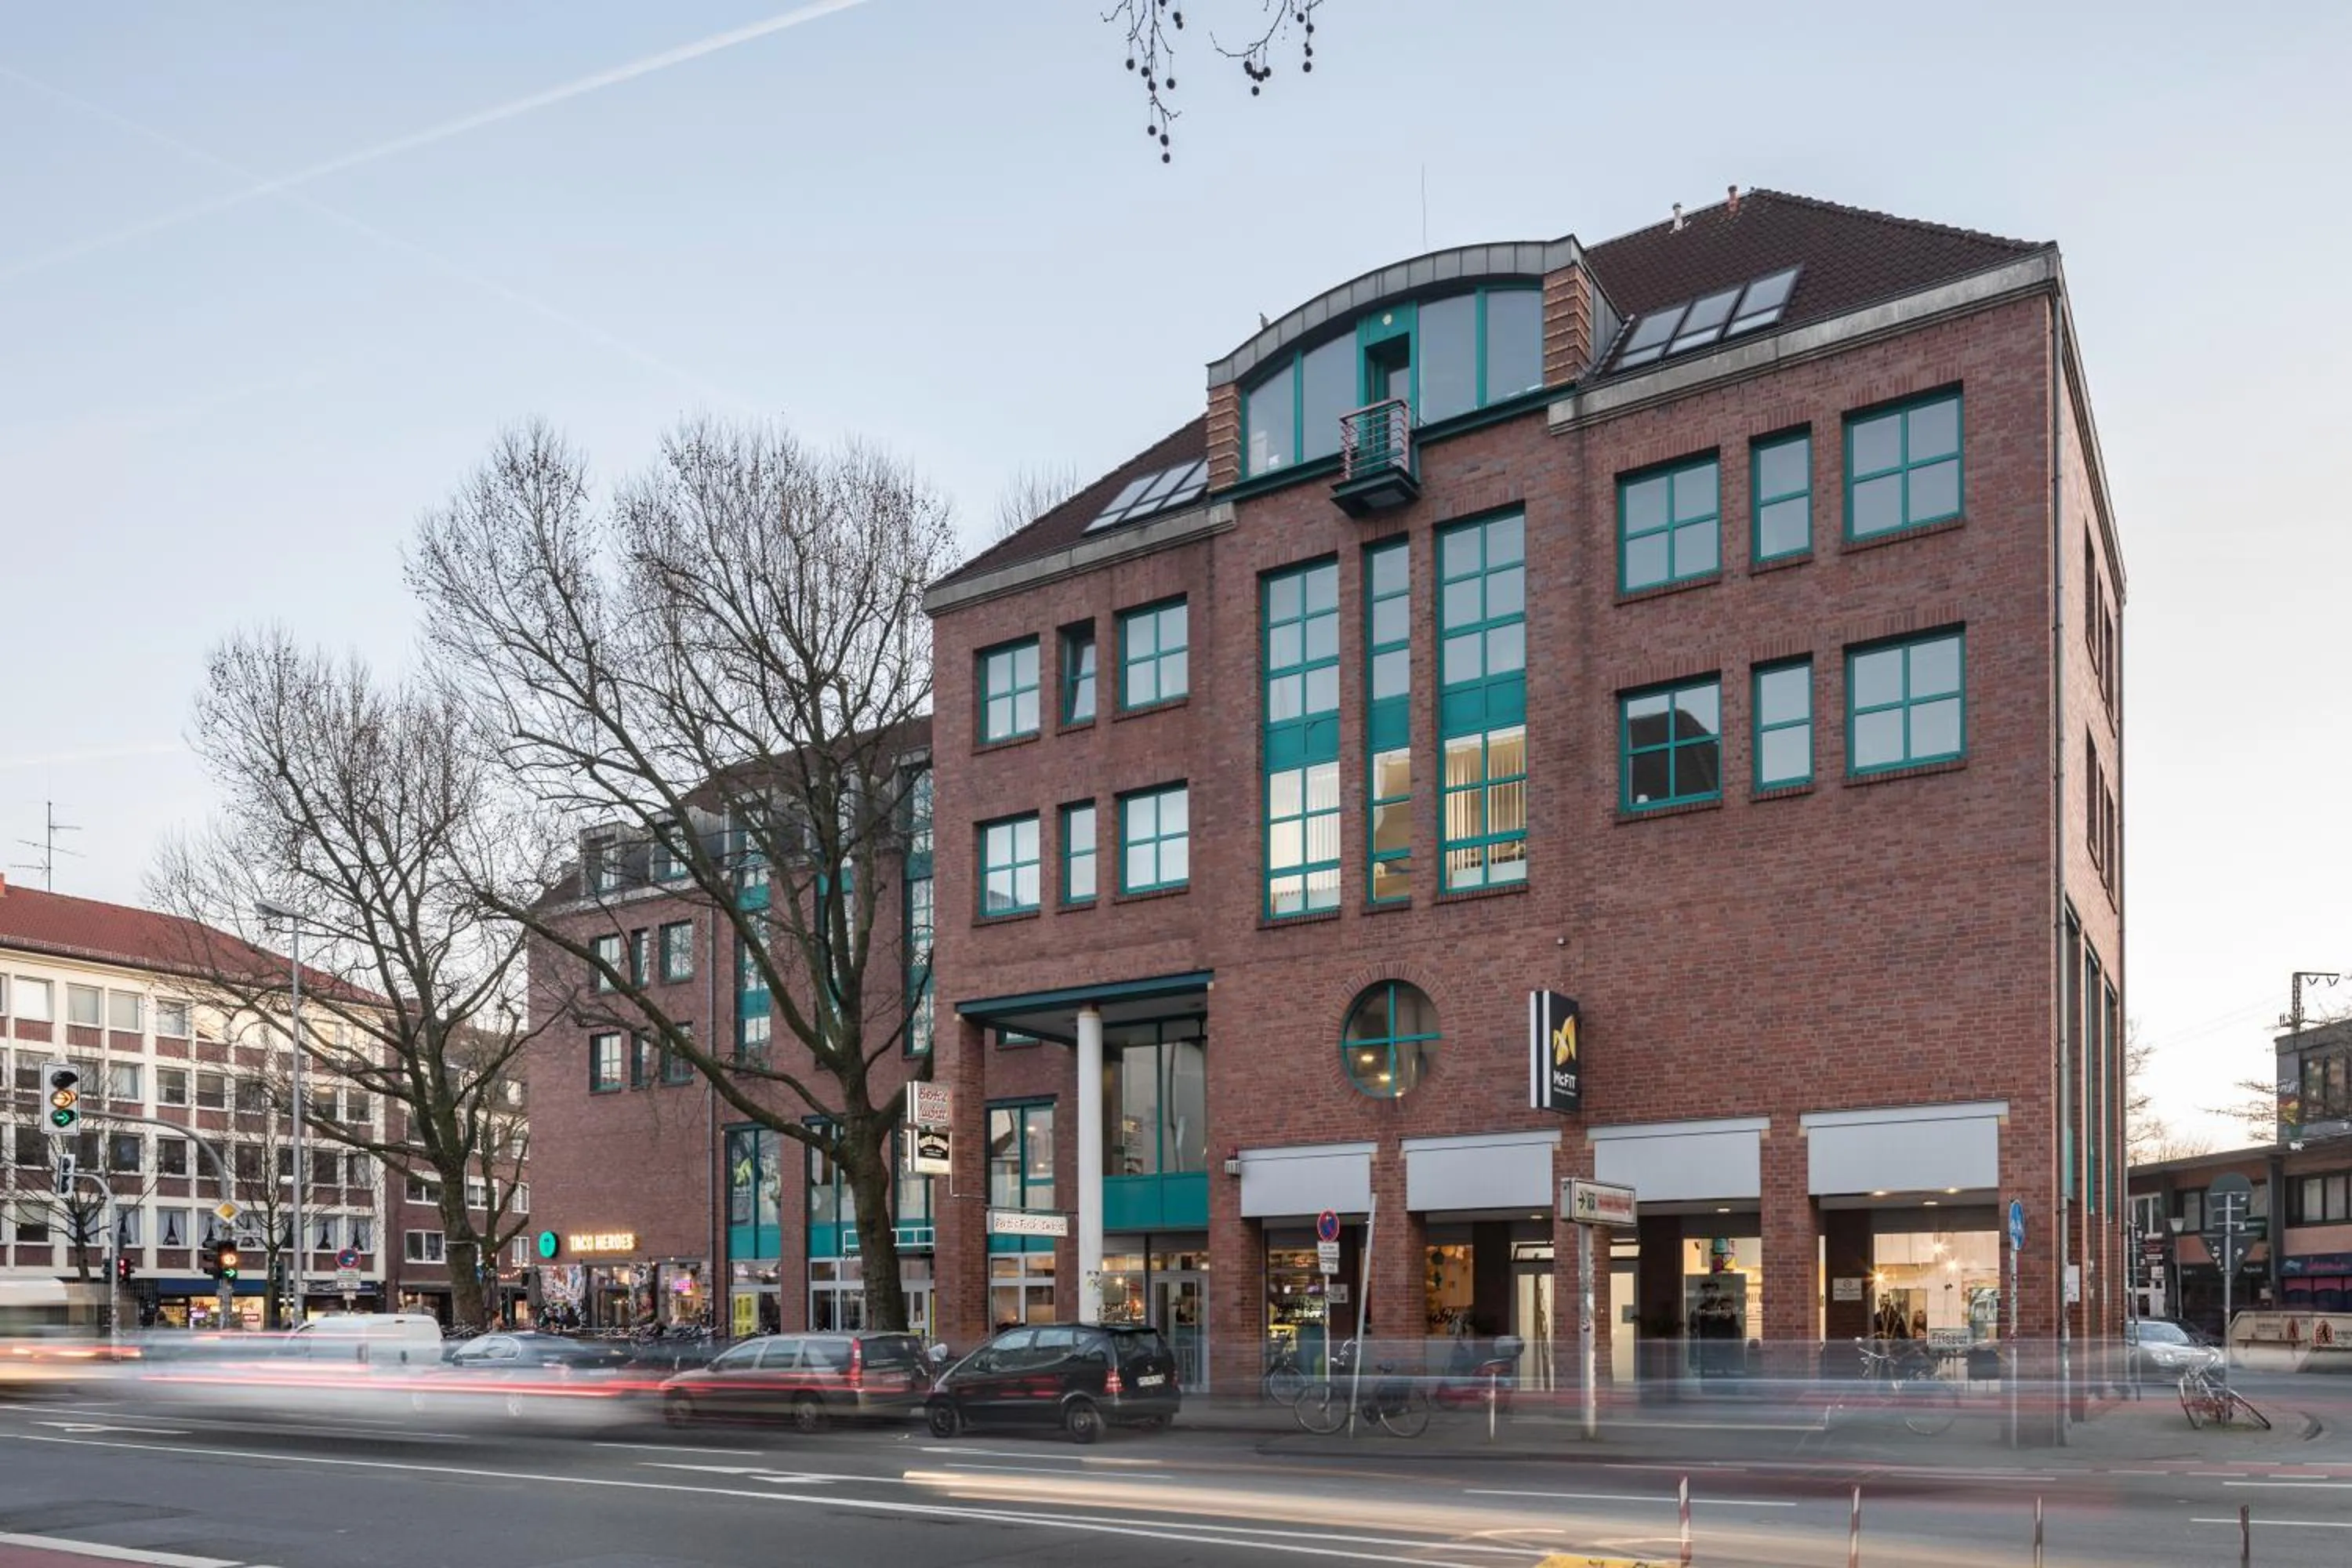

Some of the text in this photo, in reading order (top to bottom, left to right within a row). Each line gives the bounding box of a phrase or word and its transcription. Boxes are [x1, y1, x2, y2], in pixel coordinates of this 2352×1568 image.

[1553, 1070, 1576, 1090] McFIT
[569, 1233, 634, 1252] TACO HEROES
[1931, 1332, 1967, 1345] Friseur
